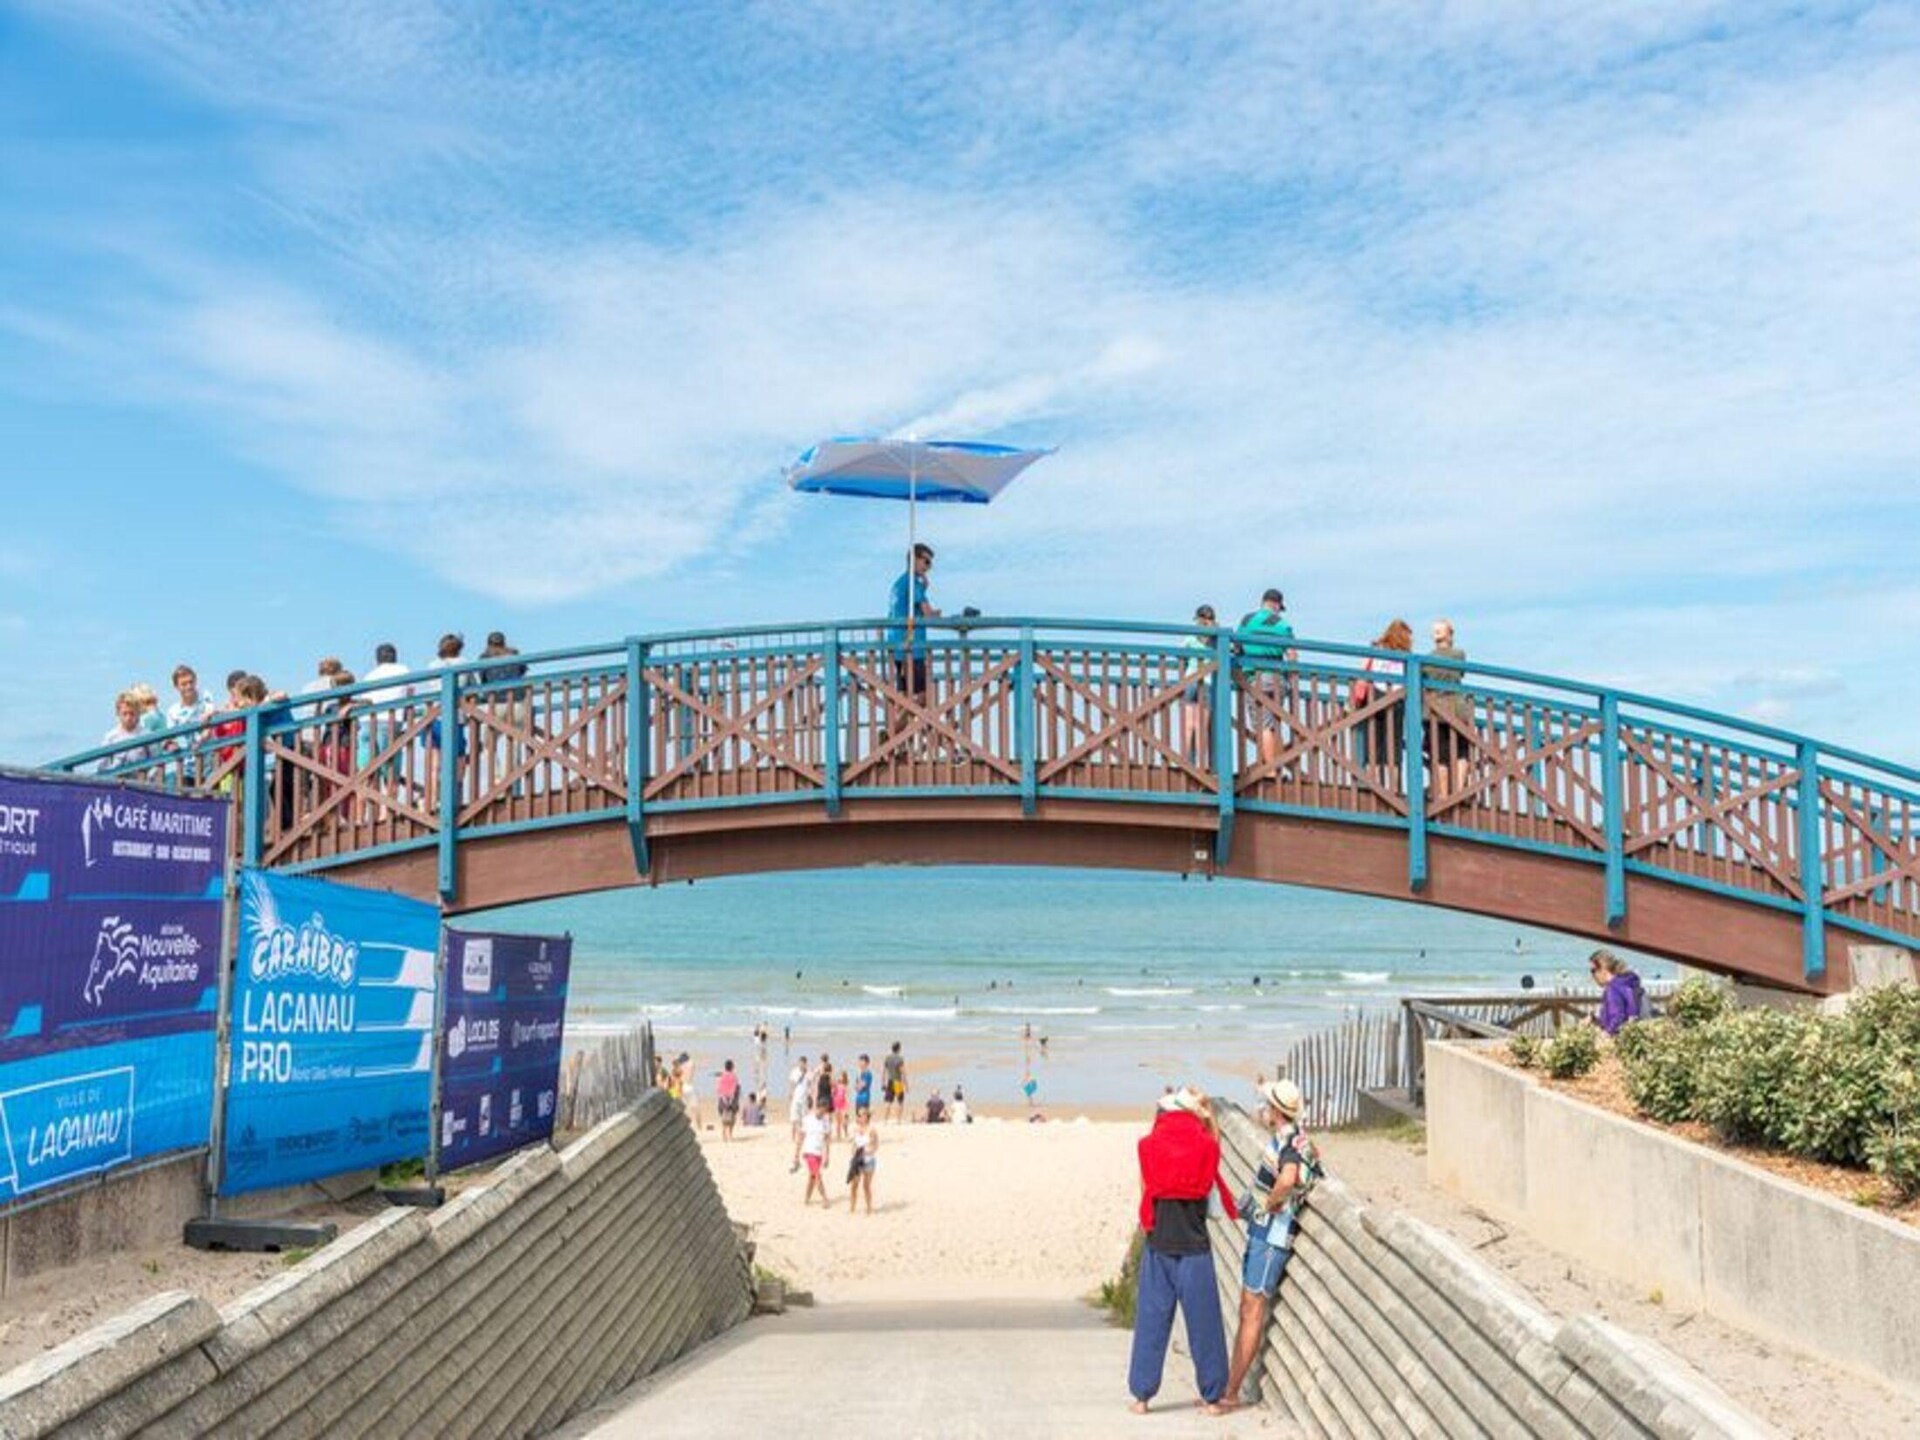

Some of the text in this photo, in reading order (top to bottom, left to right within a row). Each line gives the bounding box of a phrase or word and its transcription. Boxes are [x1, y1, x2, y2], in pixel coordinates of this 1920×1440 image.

[114, 804, 213, 837] CAFÉ MARITIME
[138, 959, 199, 991] Aquitaine
[242, 989, 356, 1033] LACANAU
[241, 1040, 292, 1084] PRO
[27, 1106, 123, 1167] LACANAU
